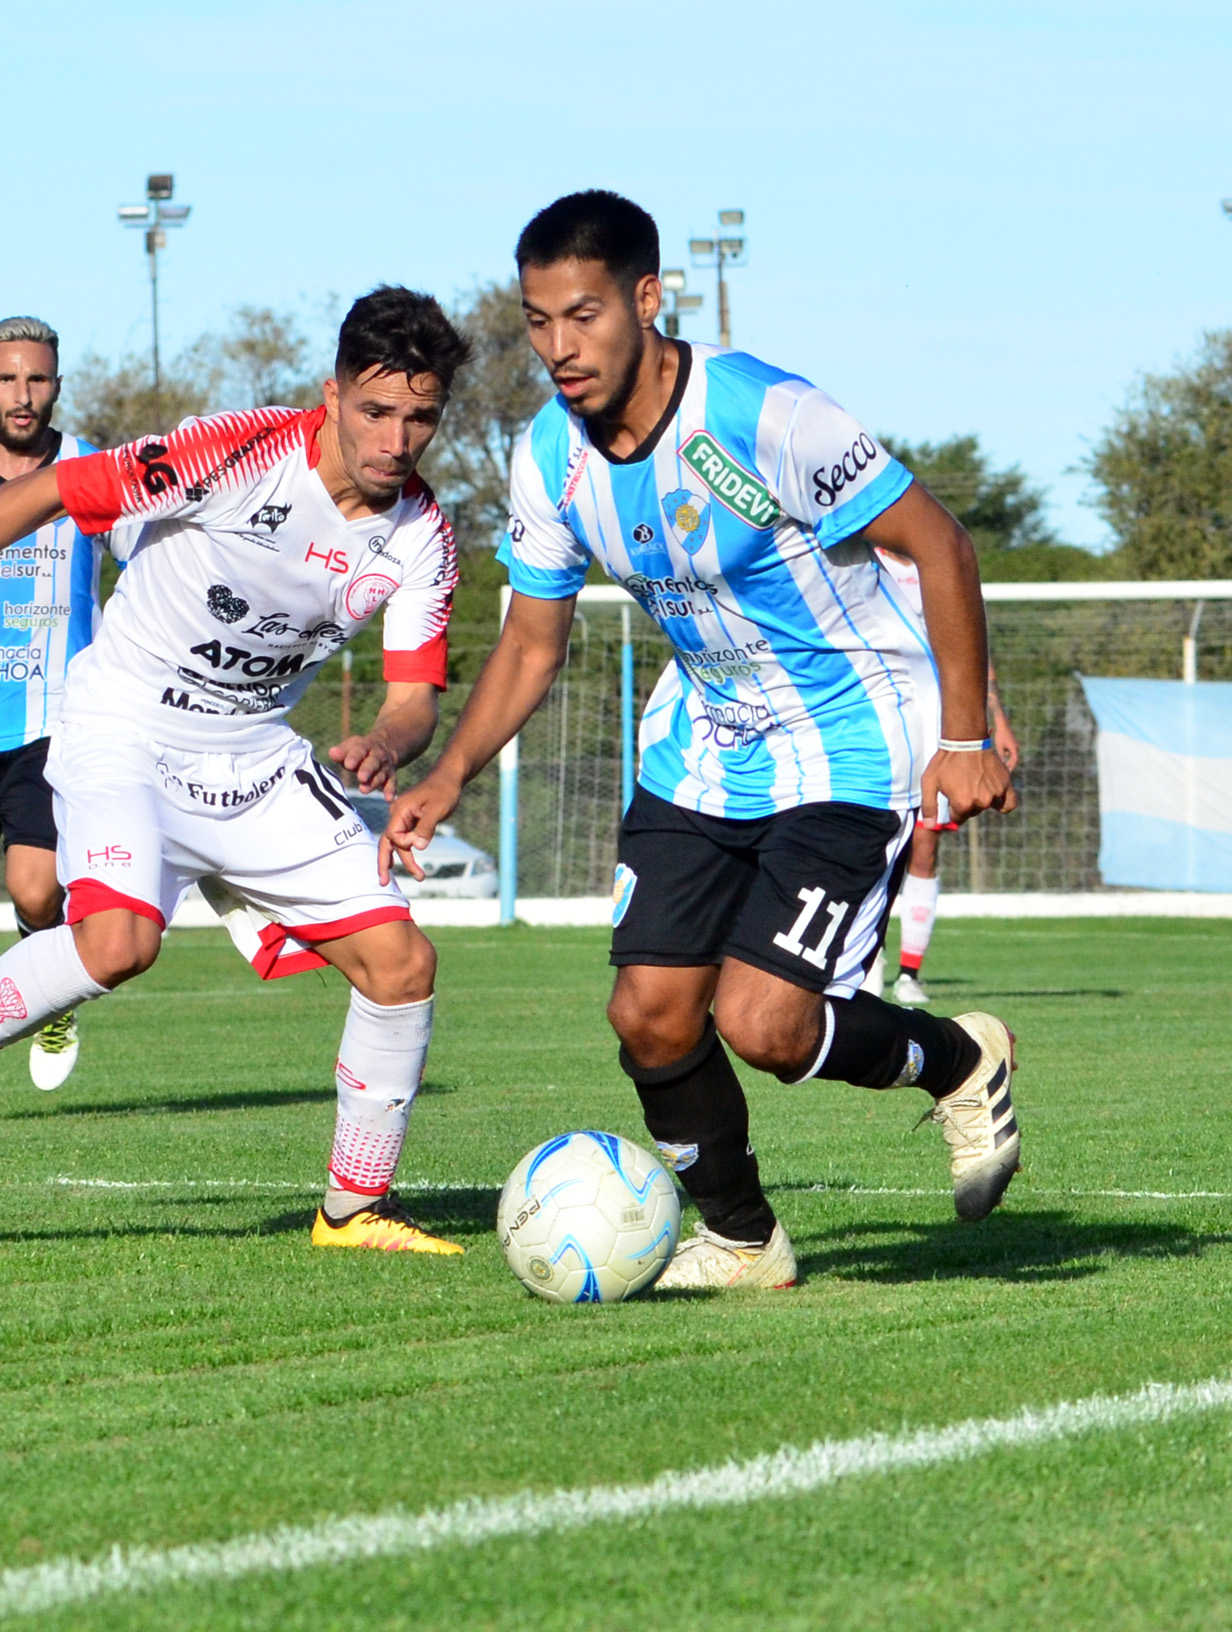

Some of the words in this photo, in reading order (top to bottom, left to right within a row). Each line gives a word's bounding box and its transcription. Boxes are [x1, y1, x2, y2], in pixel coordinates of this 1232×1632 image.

[202, 426, 276, 488] PESGRAFICA
[812, 431, 877, 507] Secco
[692, 442, 775, 523] FRIDEVI
[304, 542, 349, 575] HS
[4, 602, 71, 616] horizonte
[6, 617, 59, 629] seguros
[241, 612, 299, 639] Las
[190, 639, 322, 678] ATOM
[186, 765, 286, 808] Futbolero
[334, 822, 364, 846] Club
[87, 845, 132, 864] HS
[772, 886, 850, 971] 11
